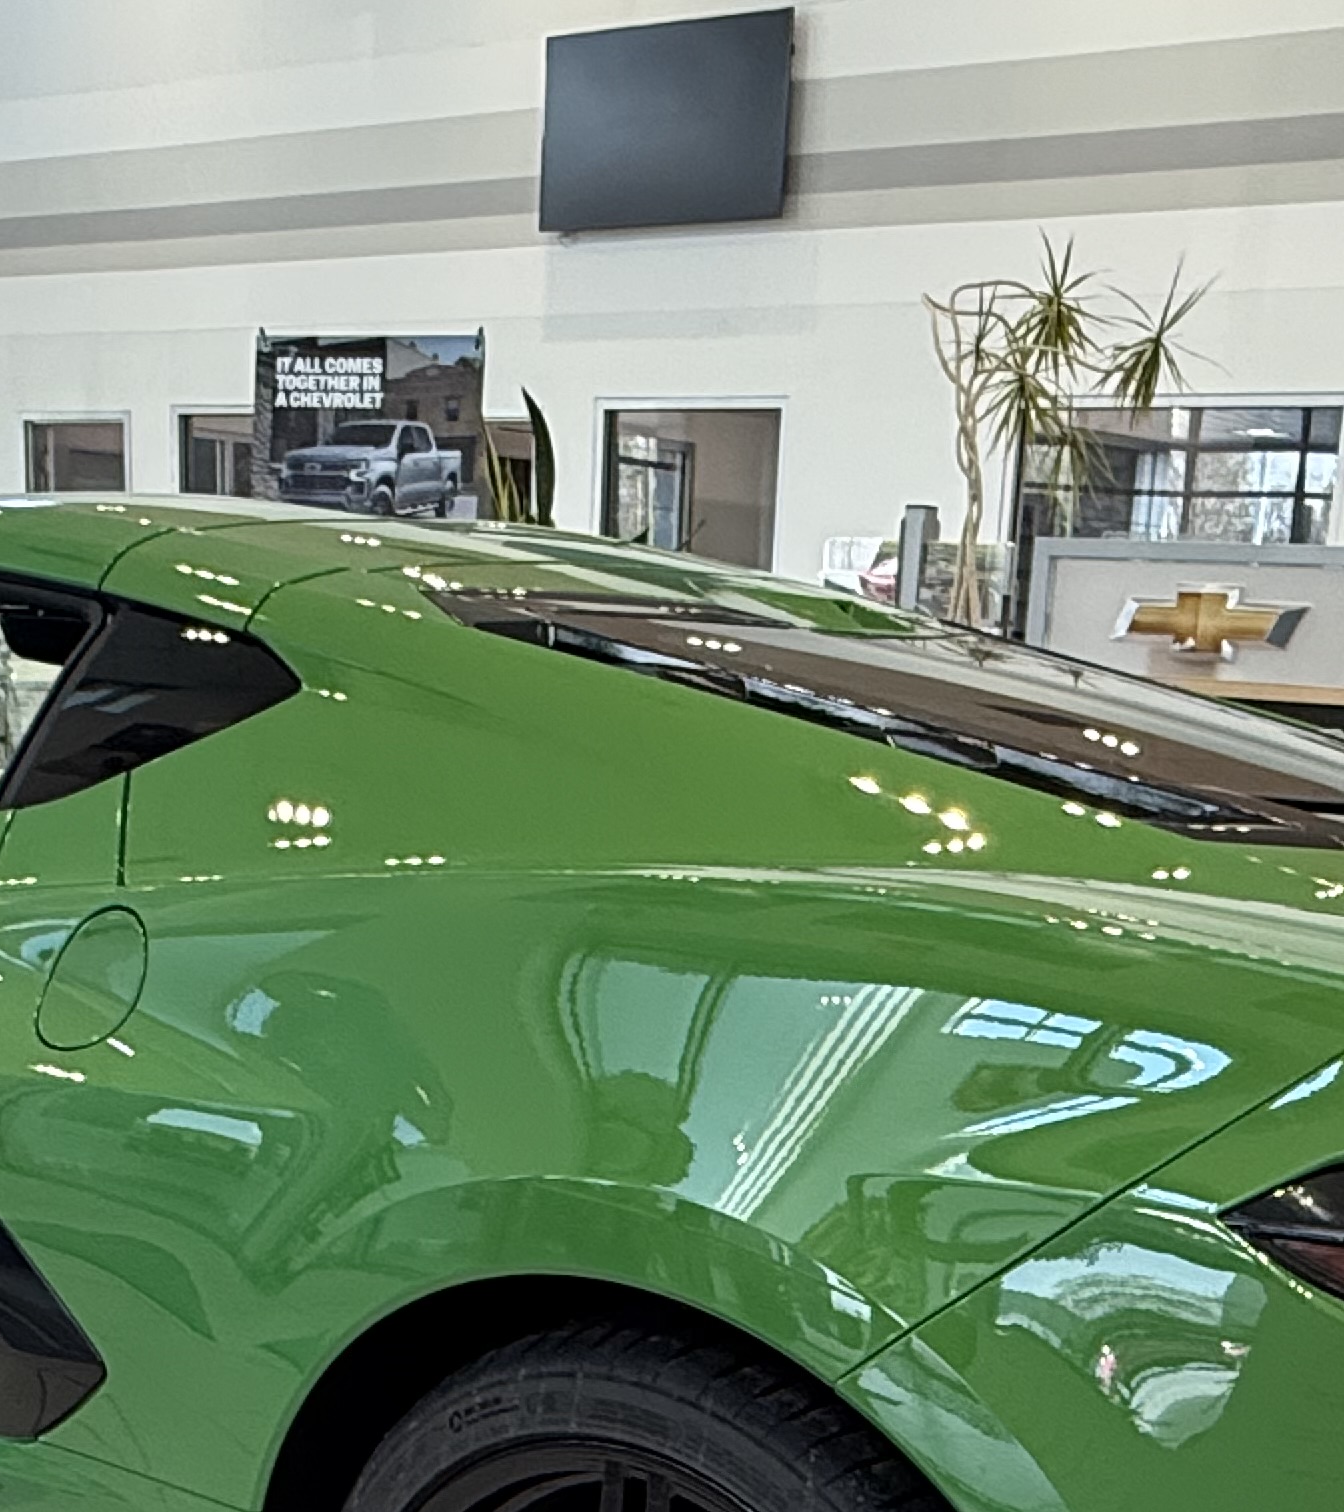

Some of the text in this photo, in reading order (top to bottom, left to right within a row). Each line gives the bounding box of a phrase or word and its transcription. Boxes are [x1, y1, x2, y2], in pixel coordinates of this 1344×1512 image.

[276, 356, 384, 374] IT ALL COMES
[275, 374, 382, 391] TOGETHER IN
[275, 392, 384, 409] A CHEVROLET
